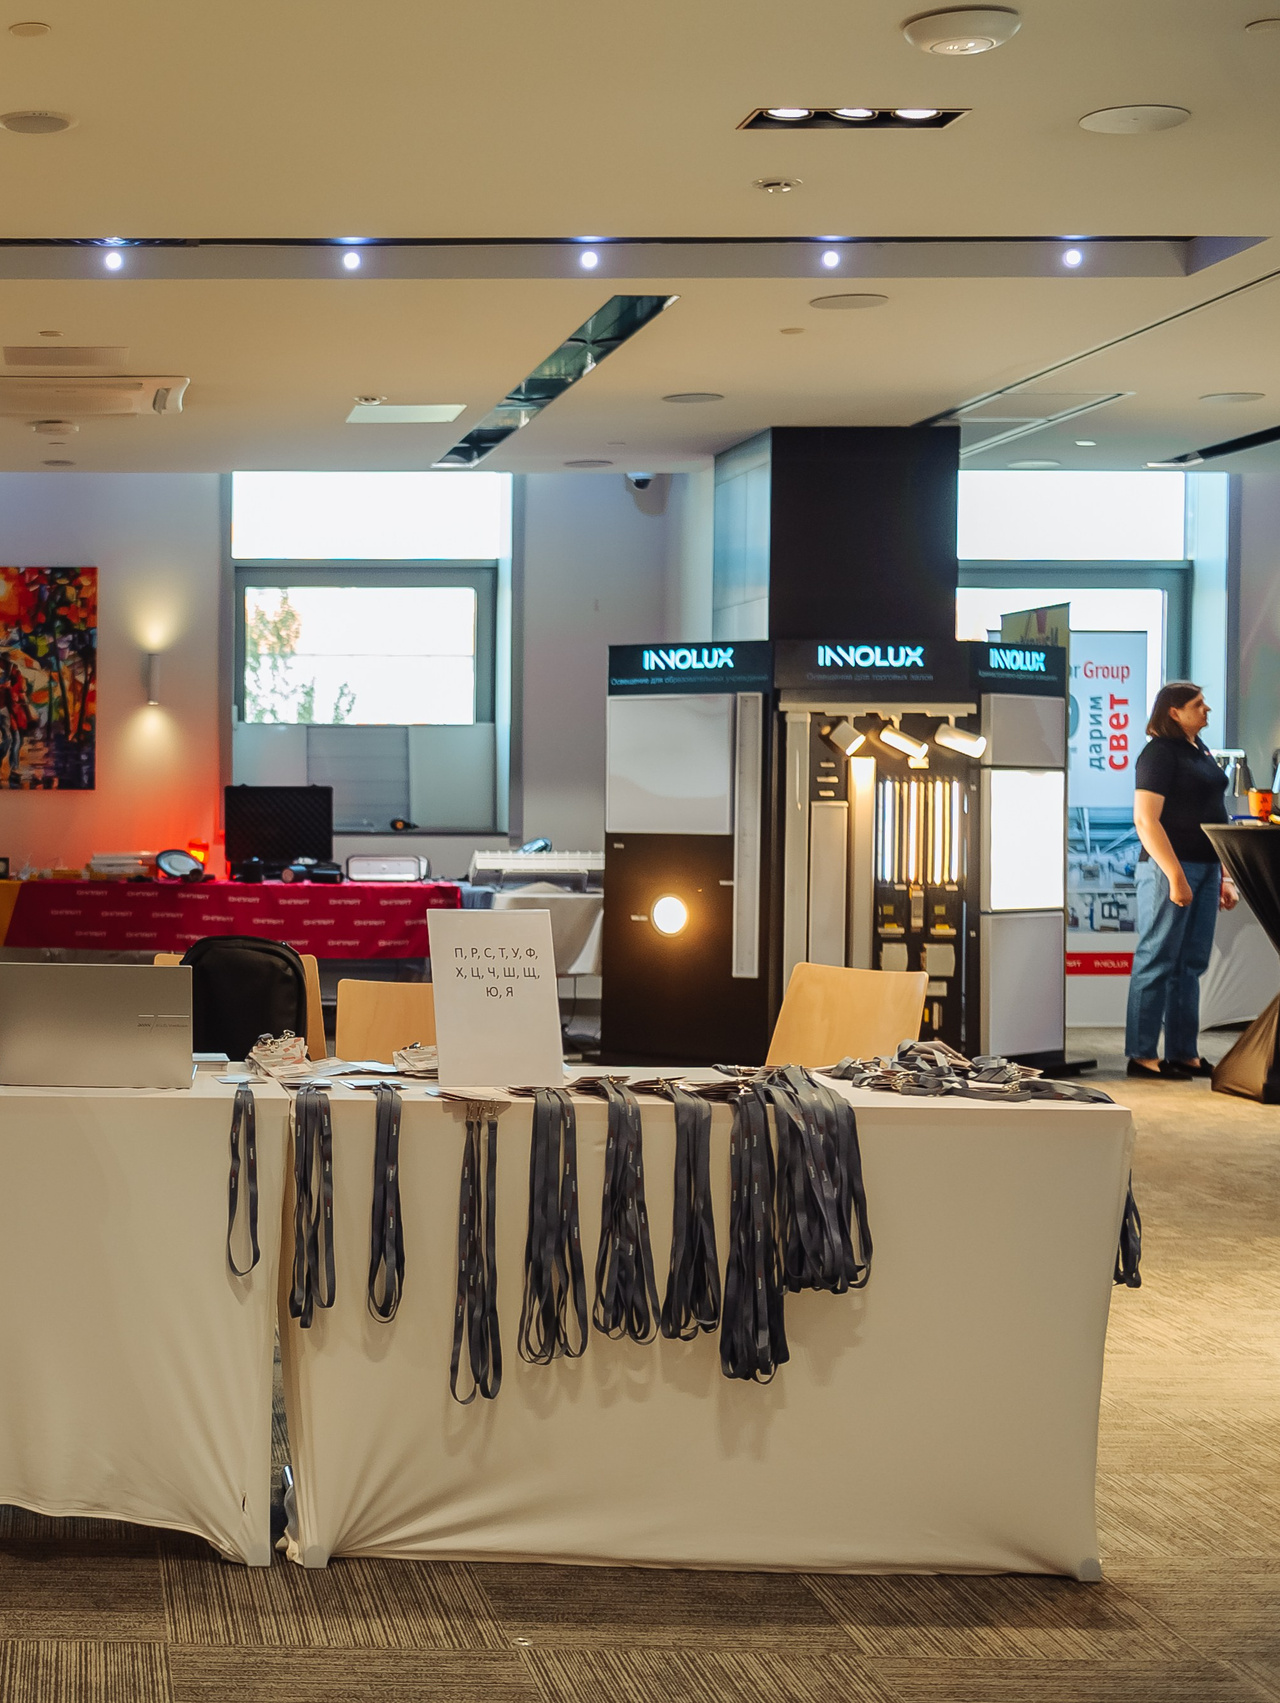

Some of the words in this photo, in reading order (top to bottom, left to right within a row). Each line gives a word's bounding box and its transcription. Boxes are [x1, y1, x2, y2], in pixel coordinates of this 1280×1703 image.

[642, 646, 735, 671] INNOLUX
[817, 645, 925, 668] INNOLUX
[989, 647, 1046, 672] INNOLUX
[1083, 661, 1131, 684] Group
[1089, 696, 1107, 772] дарим
[454, 947, 467, 960] П,
[471, 947, 481, 960] Р,
[483, 947, 496, 960] С,
[498, 947, 509, 960] Т,
[511, 947, 522, 960] У,
[525, 947, 538, 960] Ф,
[455, 967, 467, 979] Х,
[471, 967, 485, 979] Ц,
[487, 967, 500, 979] Ч,
[503, 967, 520, 979] Ш,
[523, 967, 540, 979] Щ,
[486, 986, 502, 999] Ю,
[505, 986, 514, 997] Я
